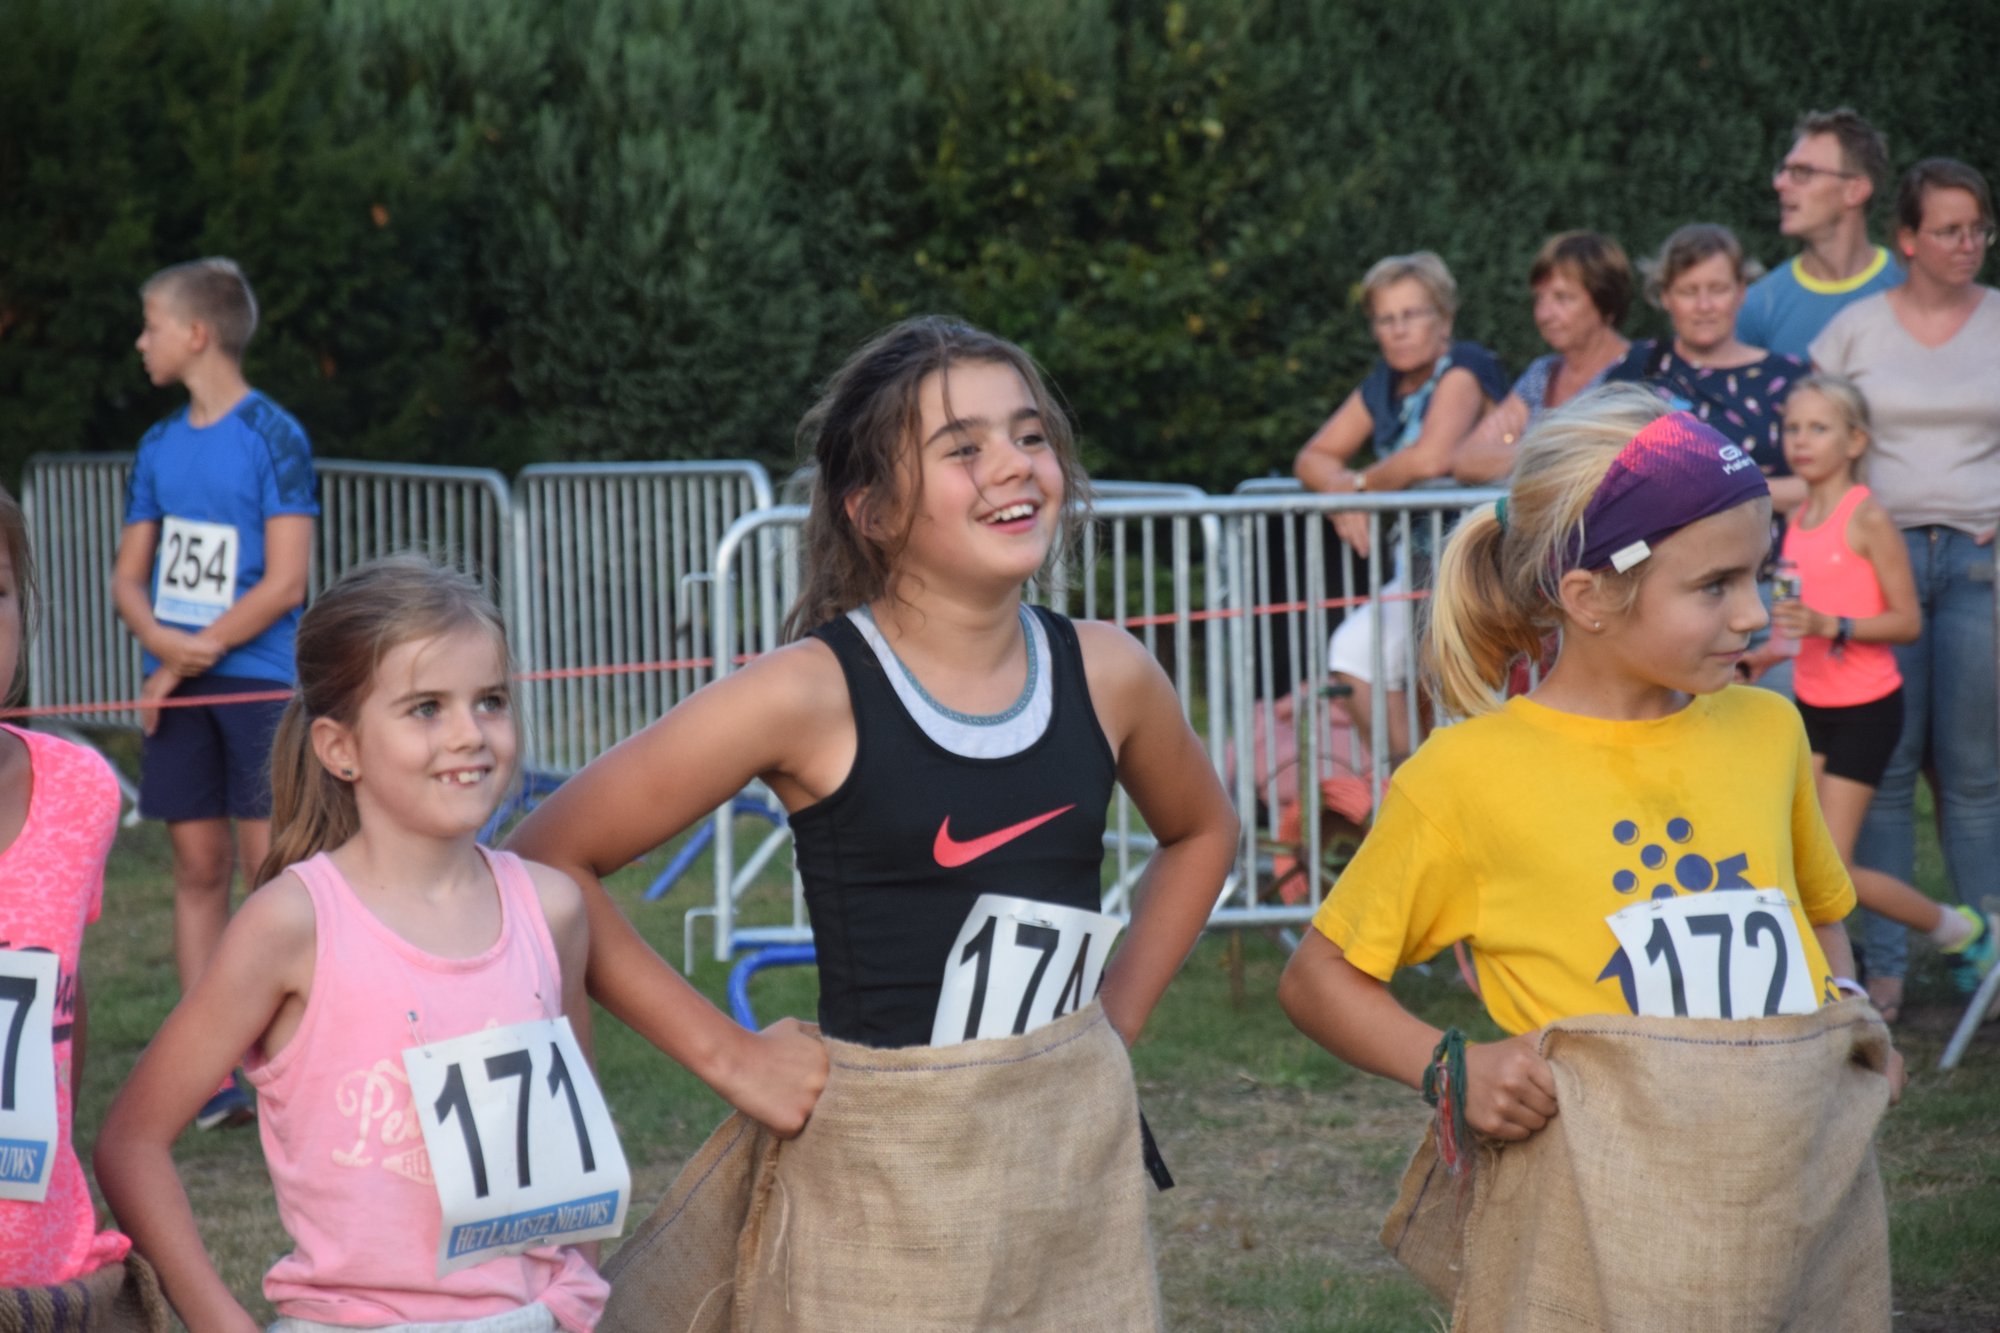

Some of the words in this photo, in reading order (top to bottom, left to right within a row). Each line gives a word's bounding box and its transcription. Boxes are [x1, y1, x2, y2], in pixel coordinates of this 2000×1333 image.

[164, 531, 227, 595] 254
[1643, 909, 1789, 1021] 172
[433, 1040, 597, 1199] 171
[454, 1225, 490, 1254] HET
[486, 1211, 555, 1246] LAATSTE
[551, 1198, 612, 1233] NIEUWS
